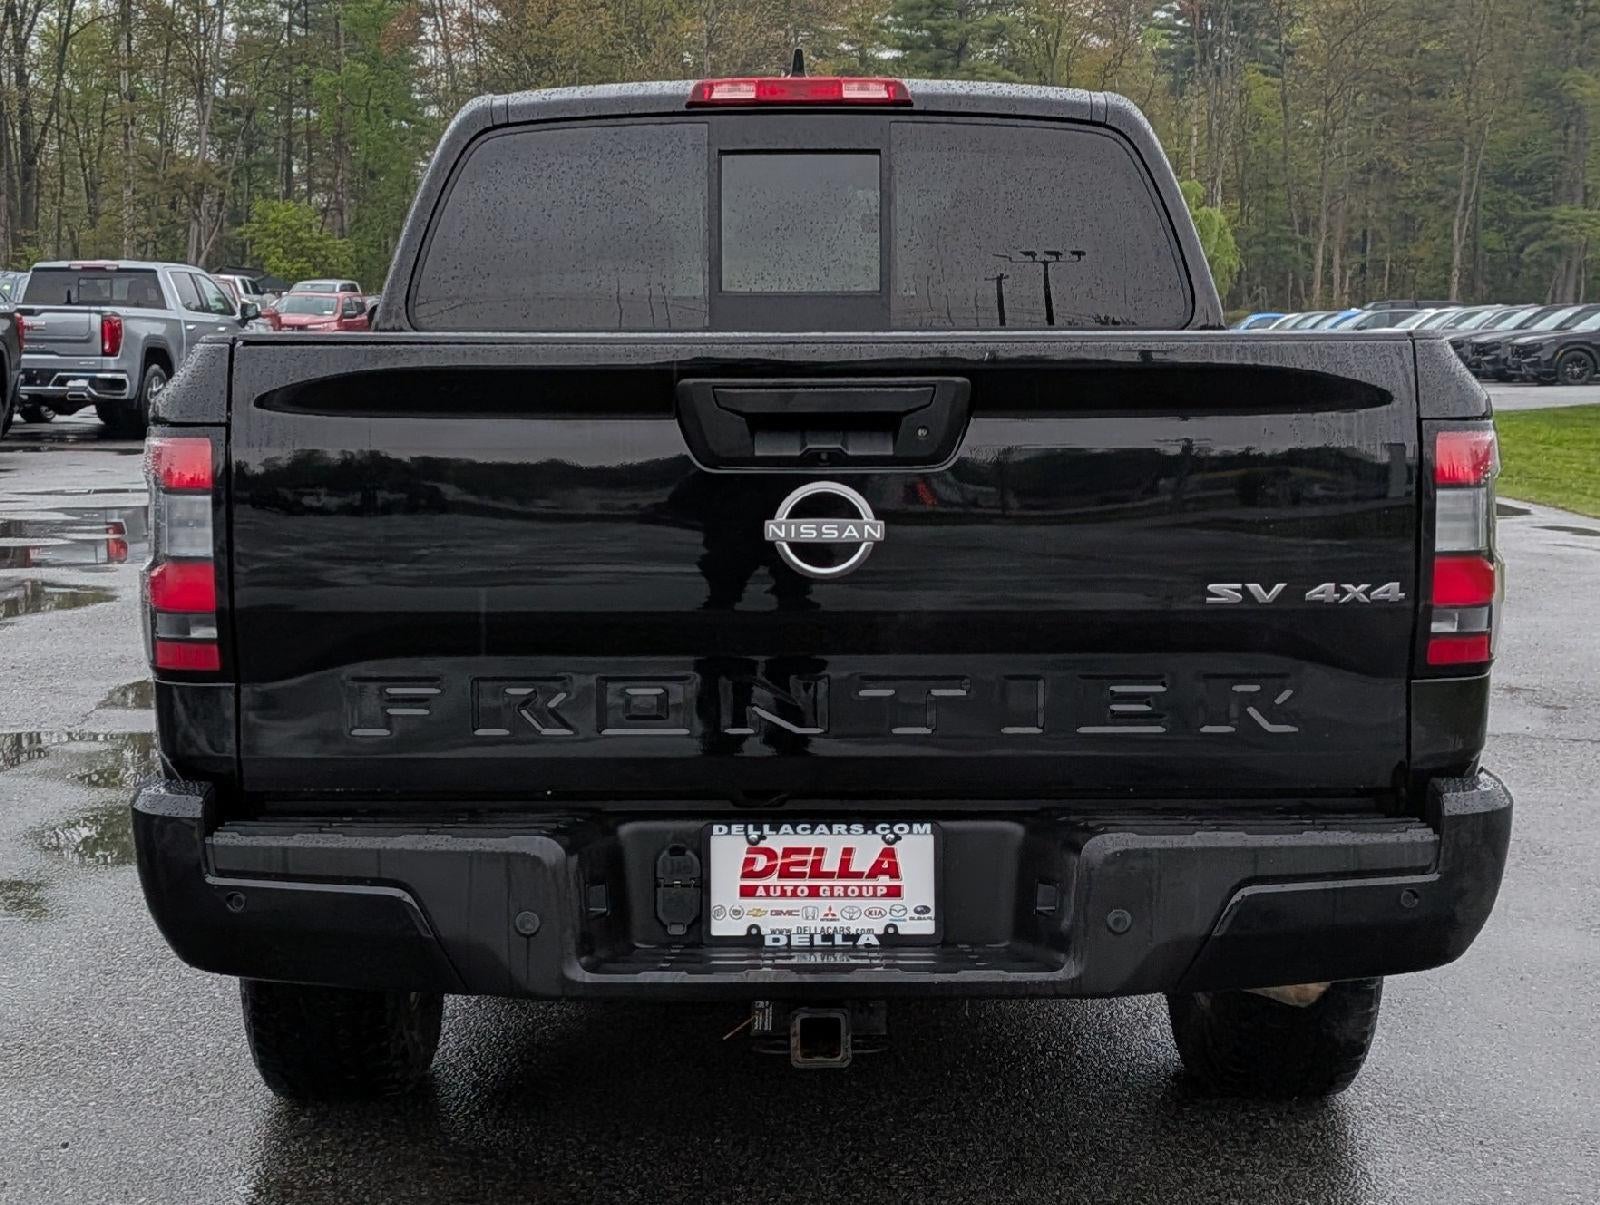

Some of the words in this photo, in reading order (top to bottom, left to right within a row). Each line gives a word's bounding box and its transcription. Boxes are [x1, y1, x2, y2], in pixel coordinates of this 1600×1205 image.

[768, 524, 881, 539] NISSAN
[1206, 583, 1288, 604] SV
[346, 672, 1303, 737] FRONTIER
[712, 823, 932, 836] DELLACARS.COM
[740, 845, 903, 882] DELLA
[755, 885, 809, 897] AUTO
[819, 885, 888, 897] GROUP
[764, 933, 880, 947] DELLA
